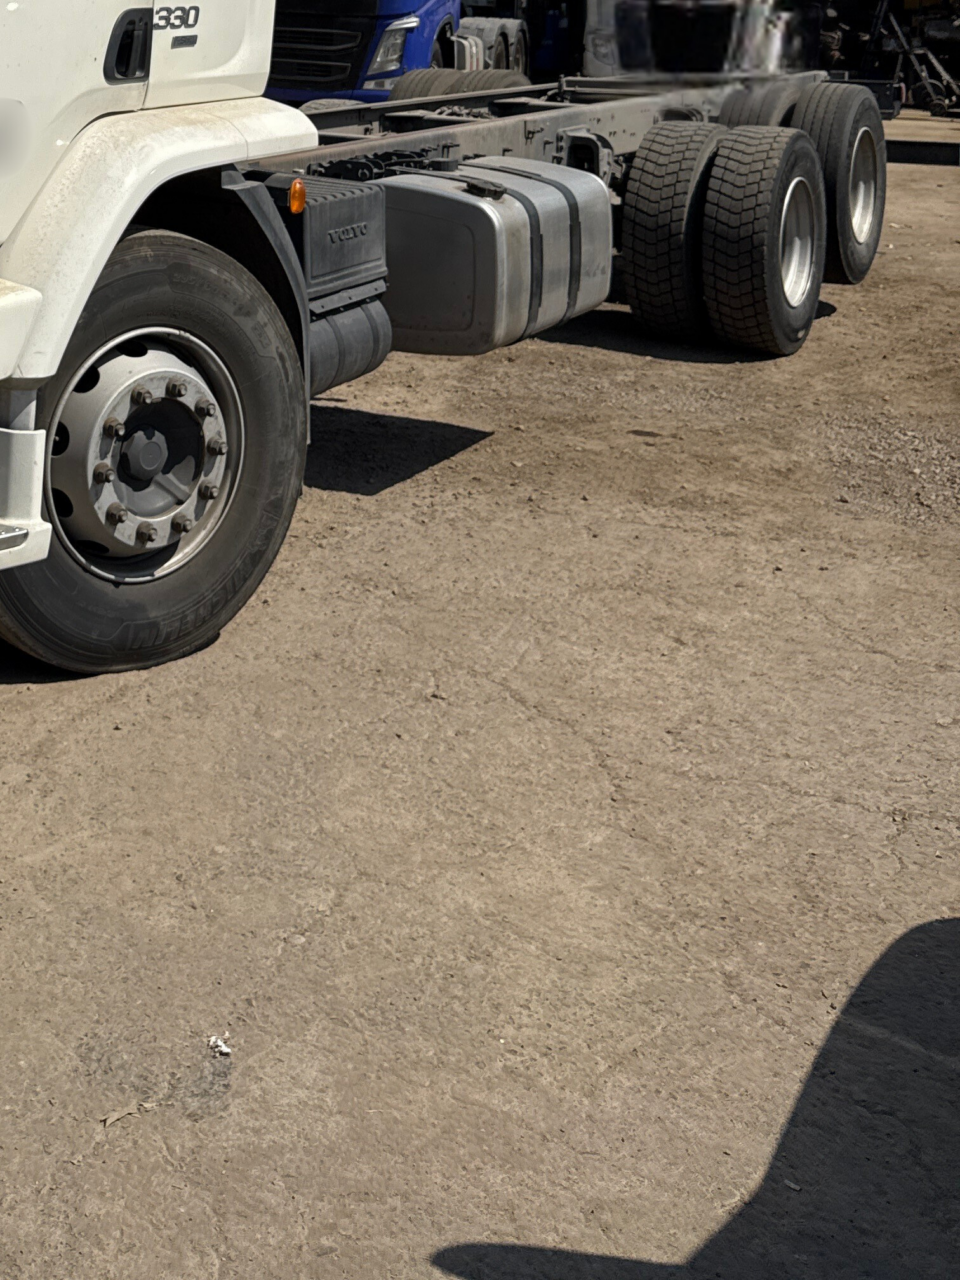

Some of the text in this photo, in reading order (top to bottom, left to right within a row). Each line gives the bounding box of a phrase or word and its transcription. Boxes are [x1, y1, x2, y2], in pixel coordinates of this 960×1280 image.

[152, 4, 201, 30] 330
[328, 221, 369, 245] VOLVO
[131, 554, 257, 649] MICHELIN
